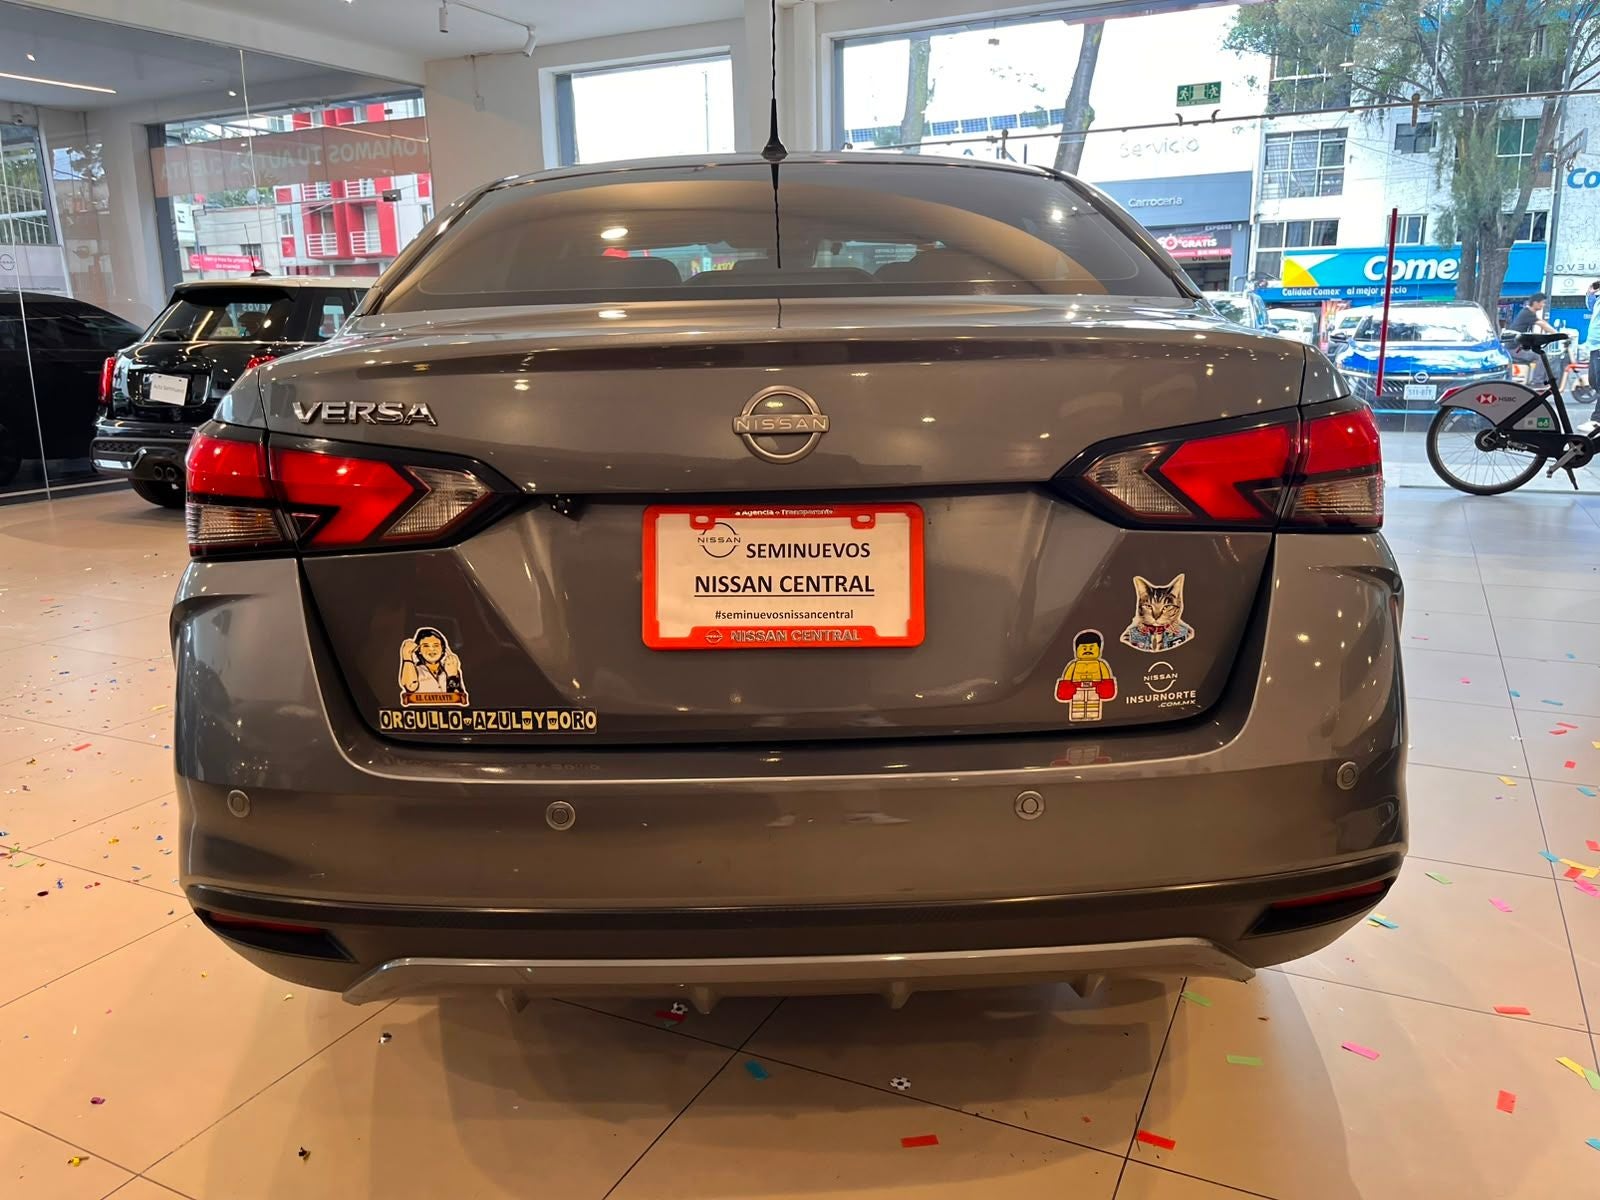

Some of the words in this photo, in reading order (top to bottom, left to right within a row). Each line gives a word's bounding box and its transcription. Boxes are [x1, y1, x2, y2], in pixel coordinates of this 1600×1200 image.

[1120, 135, 1200, 158] Servicio
[1282, 287, 1312, 297] Calidad
[1313, 287, 1340, 296] Comex
[1347, 286, 1354, 295] al
[1356, 286, 1378, 297] mejor
[1381, 286, 1407, 297] pecio
[292, 401, 438, 426] VERSA
[736, 418, 826, 431] NISSAN
[697, 536, 741, 544] NISSAN
[746, 543, 871, 558] SEMINUEVOS
[694, 575, 772, 593] NISSAN
[779, 575, 875, 593] CENTRAL
[714, 609, 854, 621] #seminuevosnissancentral
[730, 629, 787, 642] NISSAN
[791, 629, 861, 641] CENTRAL
[1143, 672, 1178, 682] NISSAN
[1126, 690, 1197, 704] INSURNORTE
